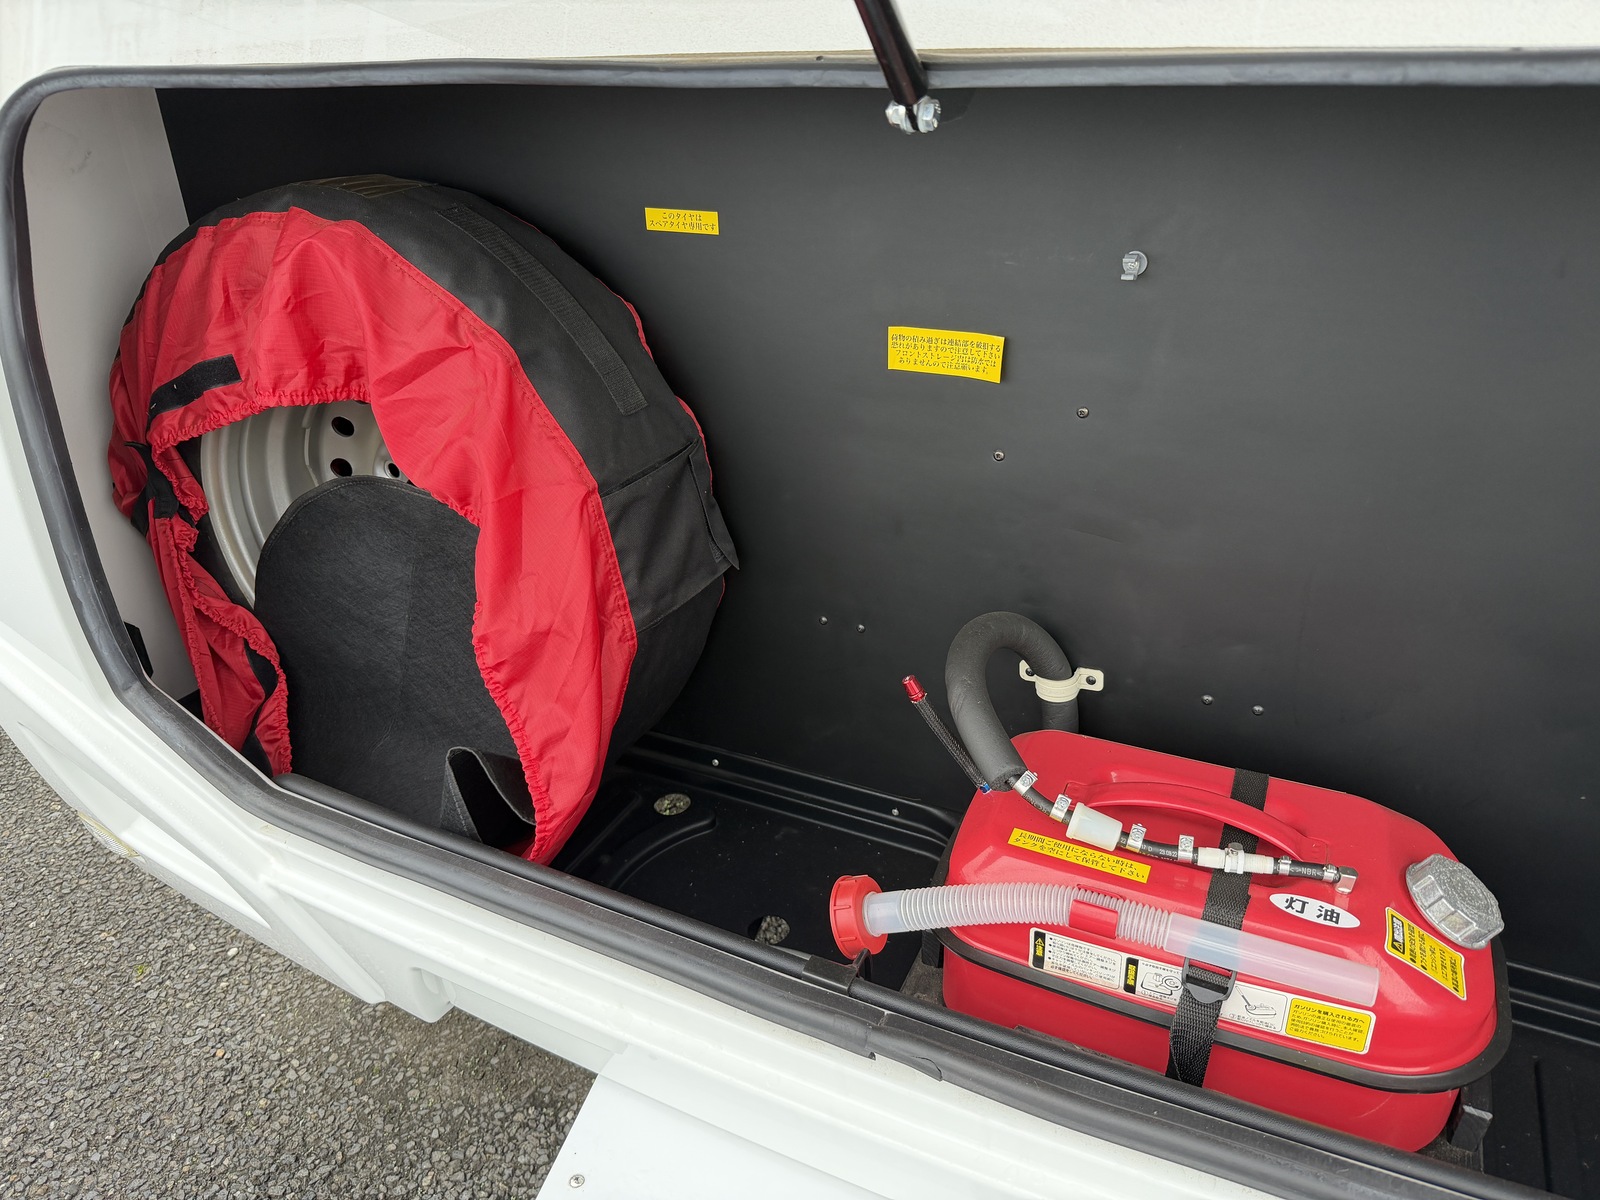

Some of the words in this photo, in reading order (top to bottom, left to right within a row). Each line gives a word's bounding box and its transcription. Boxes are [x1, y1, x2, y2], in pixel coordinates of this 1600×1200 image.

[662, 212, 702, 221] このタイヤは
[650, 220, 716, 231] スペアタイヤ専用です
[1284, 896, 1341, 925] 灯油
